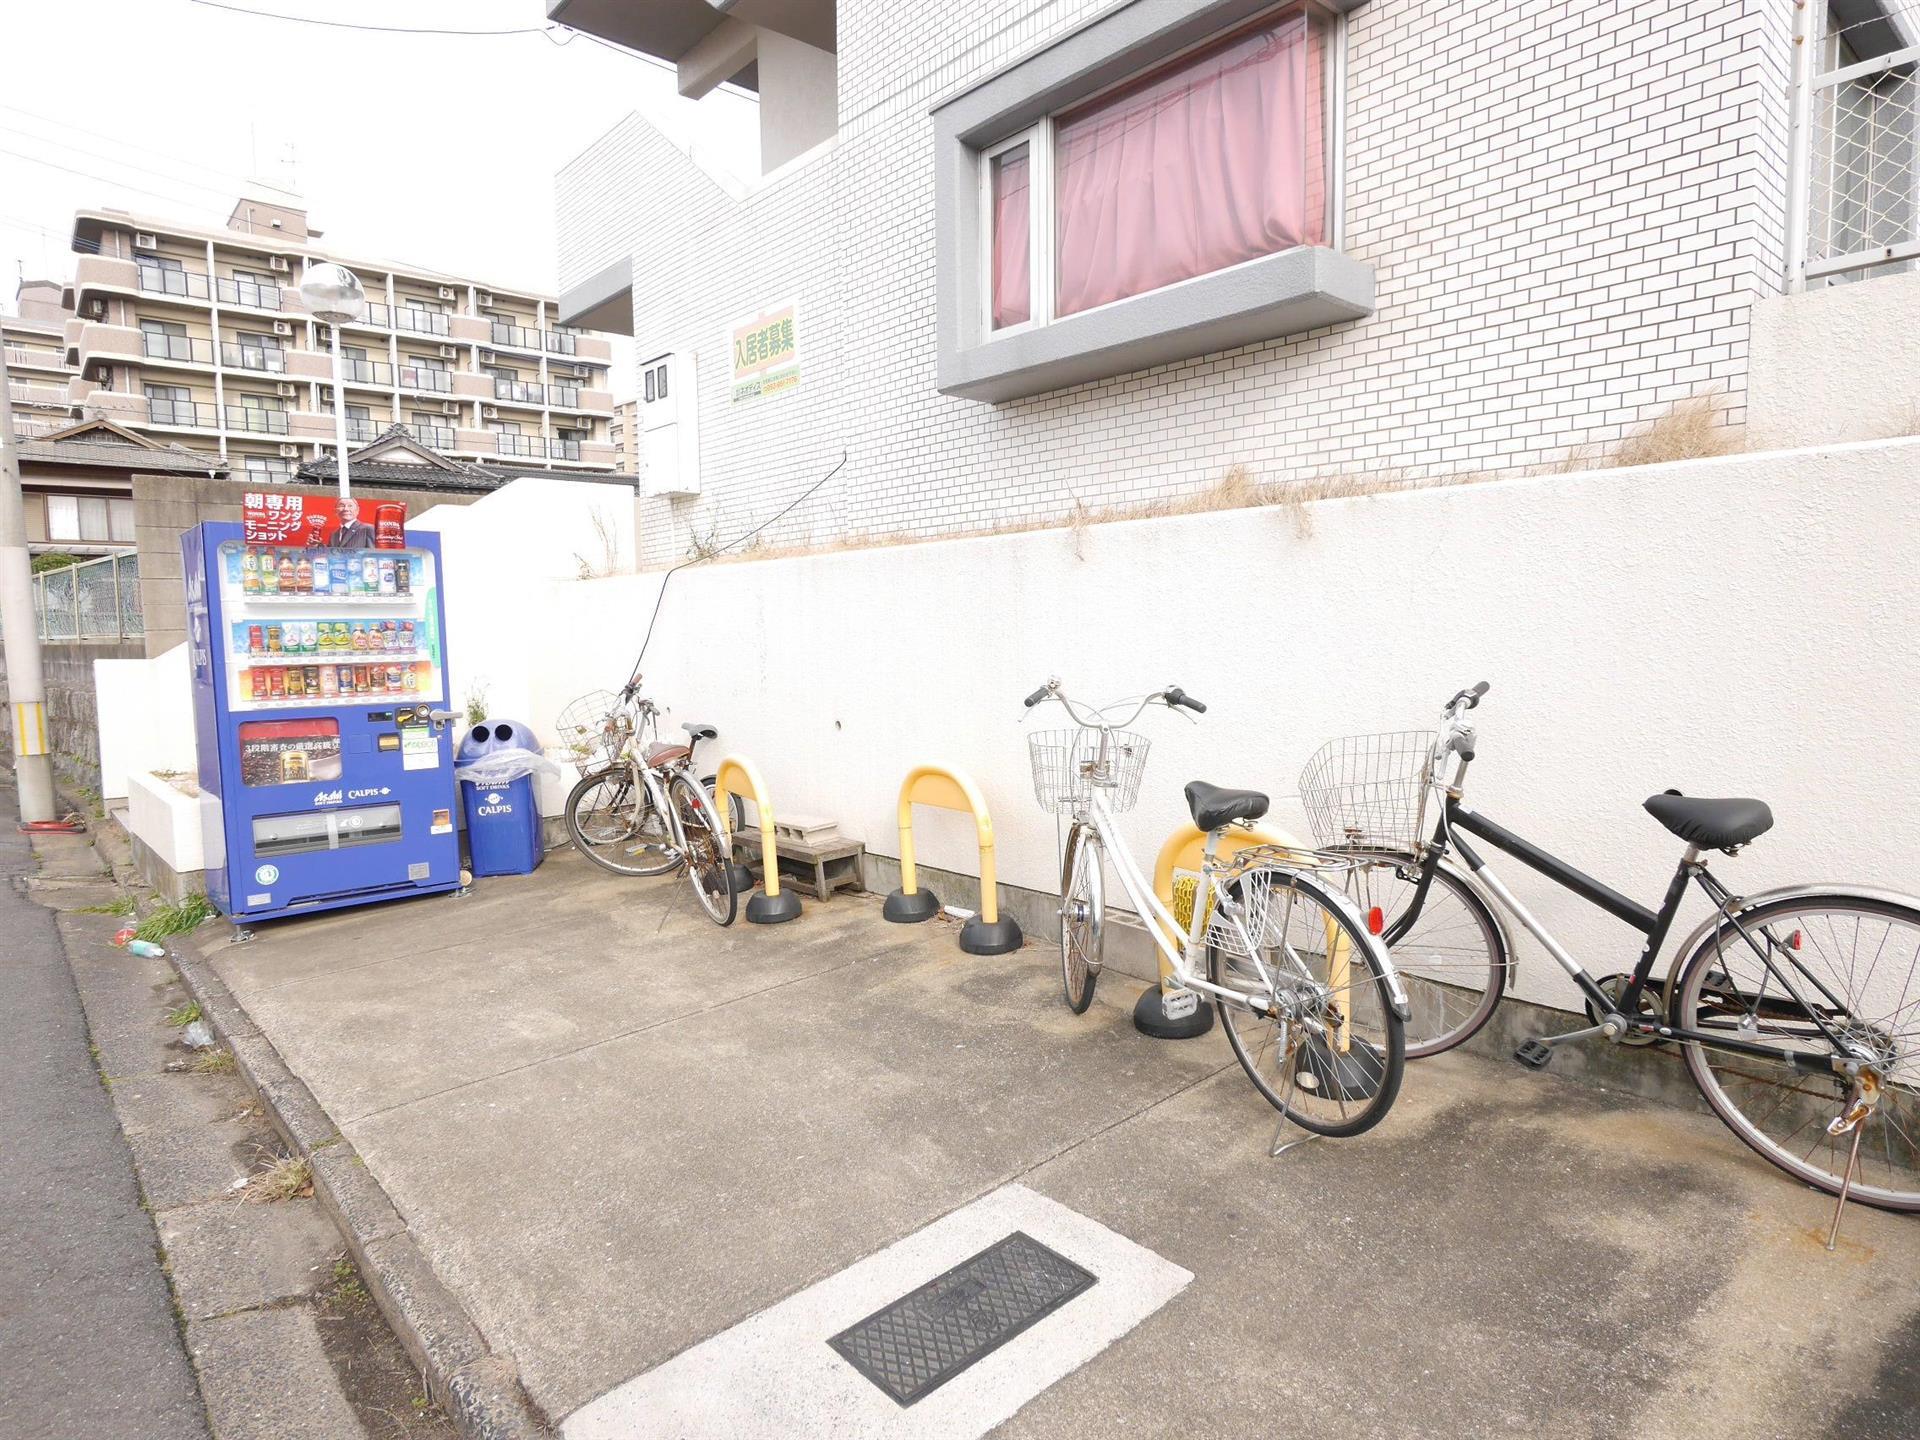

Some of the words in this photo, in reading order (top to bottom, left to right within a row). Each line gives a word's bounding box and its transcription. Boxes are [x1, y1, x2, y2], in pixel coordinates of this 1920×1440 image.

[736, 318, 794, 369] 入居者募集
[245, 493, 303, 510] 朝専用
[269, 511, 303, 521] ワンダ
[245, 520, 302, 531] モーニング
[246, 530, 288, 541] ショット
[348, 787, 379, 799] CALPIS
[478, 804, 512, 816] CALPIS
